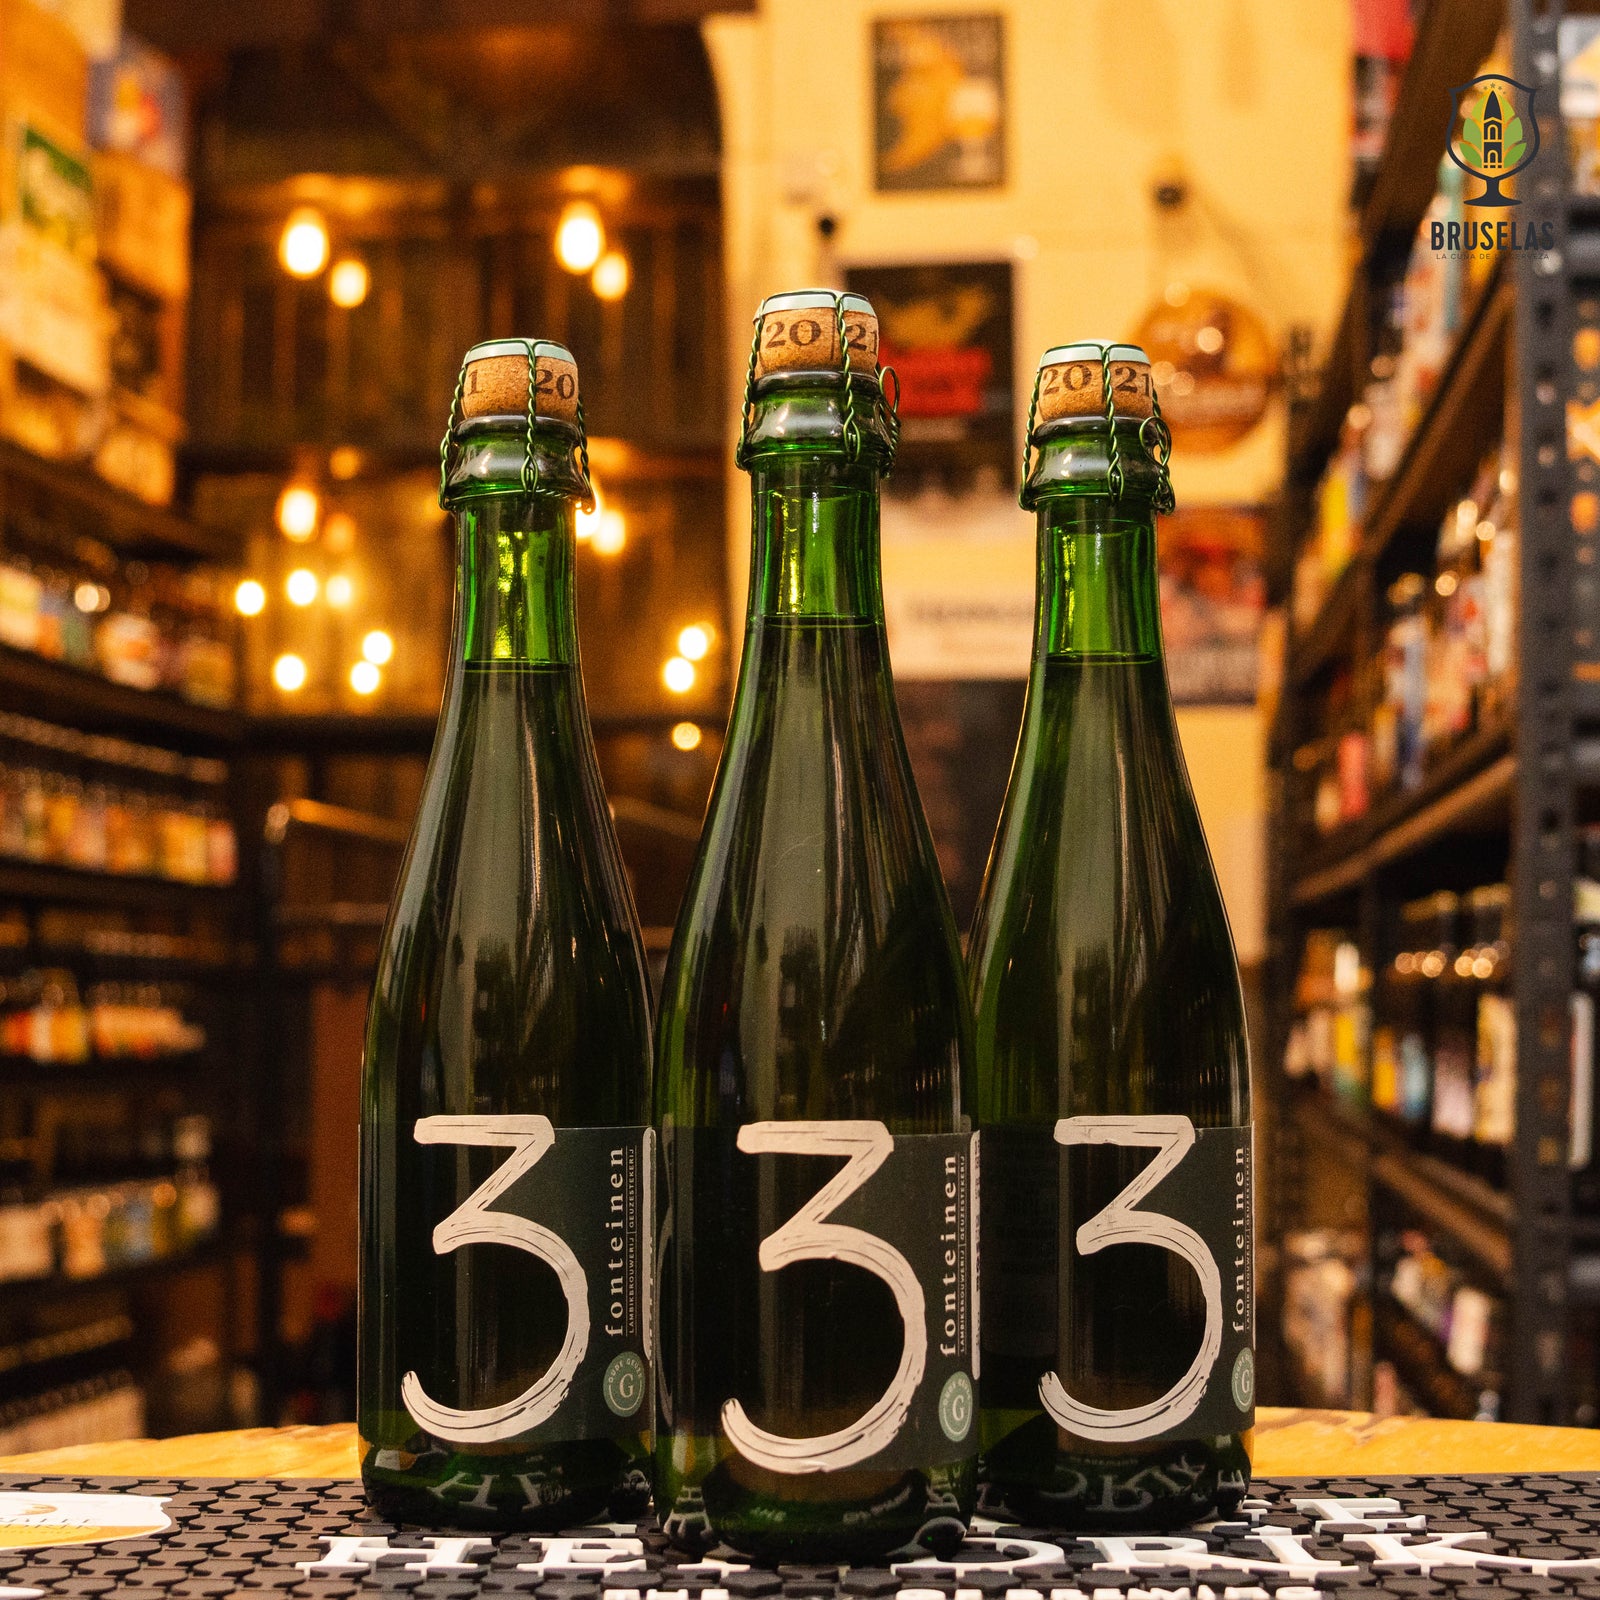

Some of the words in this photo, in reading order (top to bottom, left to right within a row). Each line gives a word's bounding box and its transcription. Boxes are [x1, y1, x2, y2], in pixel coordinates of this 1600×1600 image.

[766, 319, 821, 348] 20
[536, 368, 574, 399] 20
[1043, 364, 1092, 396] 20
[1115, 366, 1150, 398] 21
[605, 1148, 624, 1337] fonteinen
[940, 1155, 956, 1356] fonteinen
[1233, 1147, 1245, 1333] fonteinen
[400, 1114, 590, 1443] 3
[721, 1120, 927, 1474] 3
[1038, 1114, 1223, 1443] 3
[619, 1373, 634, 1398] G
[1241, 1369, 1249, 1394] G
[952, 1395, 964, 1421] G
[295, 1532, 1600, 1578] HEDRIK
